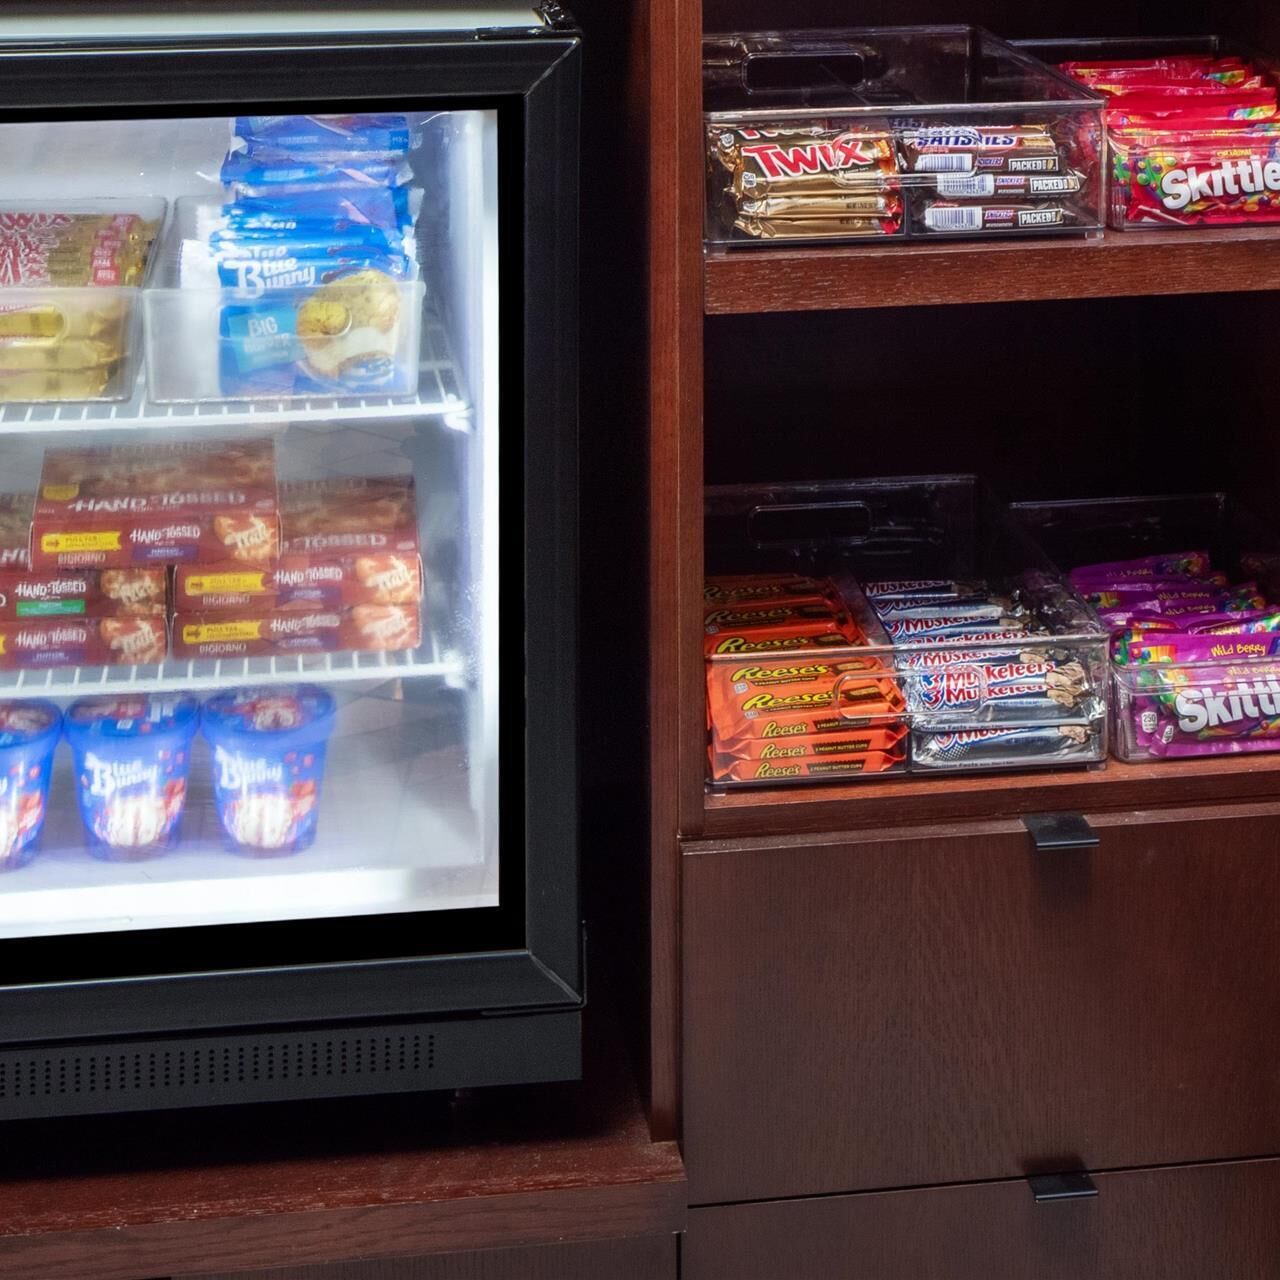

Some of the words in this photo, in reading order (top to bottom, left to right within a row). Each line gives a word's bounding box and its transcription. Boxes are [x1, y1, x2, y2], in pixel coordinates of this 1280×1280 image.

[741, 141, 874, 182] TWIX
[997, 177, 1024, 185] SNICKERS
[1033, 180, 1062, 190] PACKED
[1021, 214, 1051, 224] PACKED
[237, 265, 316, 298] Bunny
[717, 637, 809, 654] Reese's
[1211, 643, 1234, 657] Wild
[1237, 645, 1266, 656] Berry
[731, 664, 828, 682] Reese's
[761, 722, 807, 738] Reese's
[761, 744, 806, 759] Reese's
[755, 763, 800, 778] Reese's
